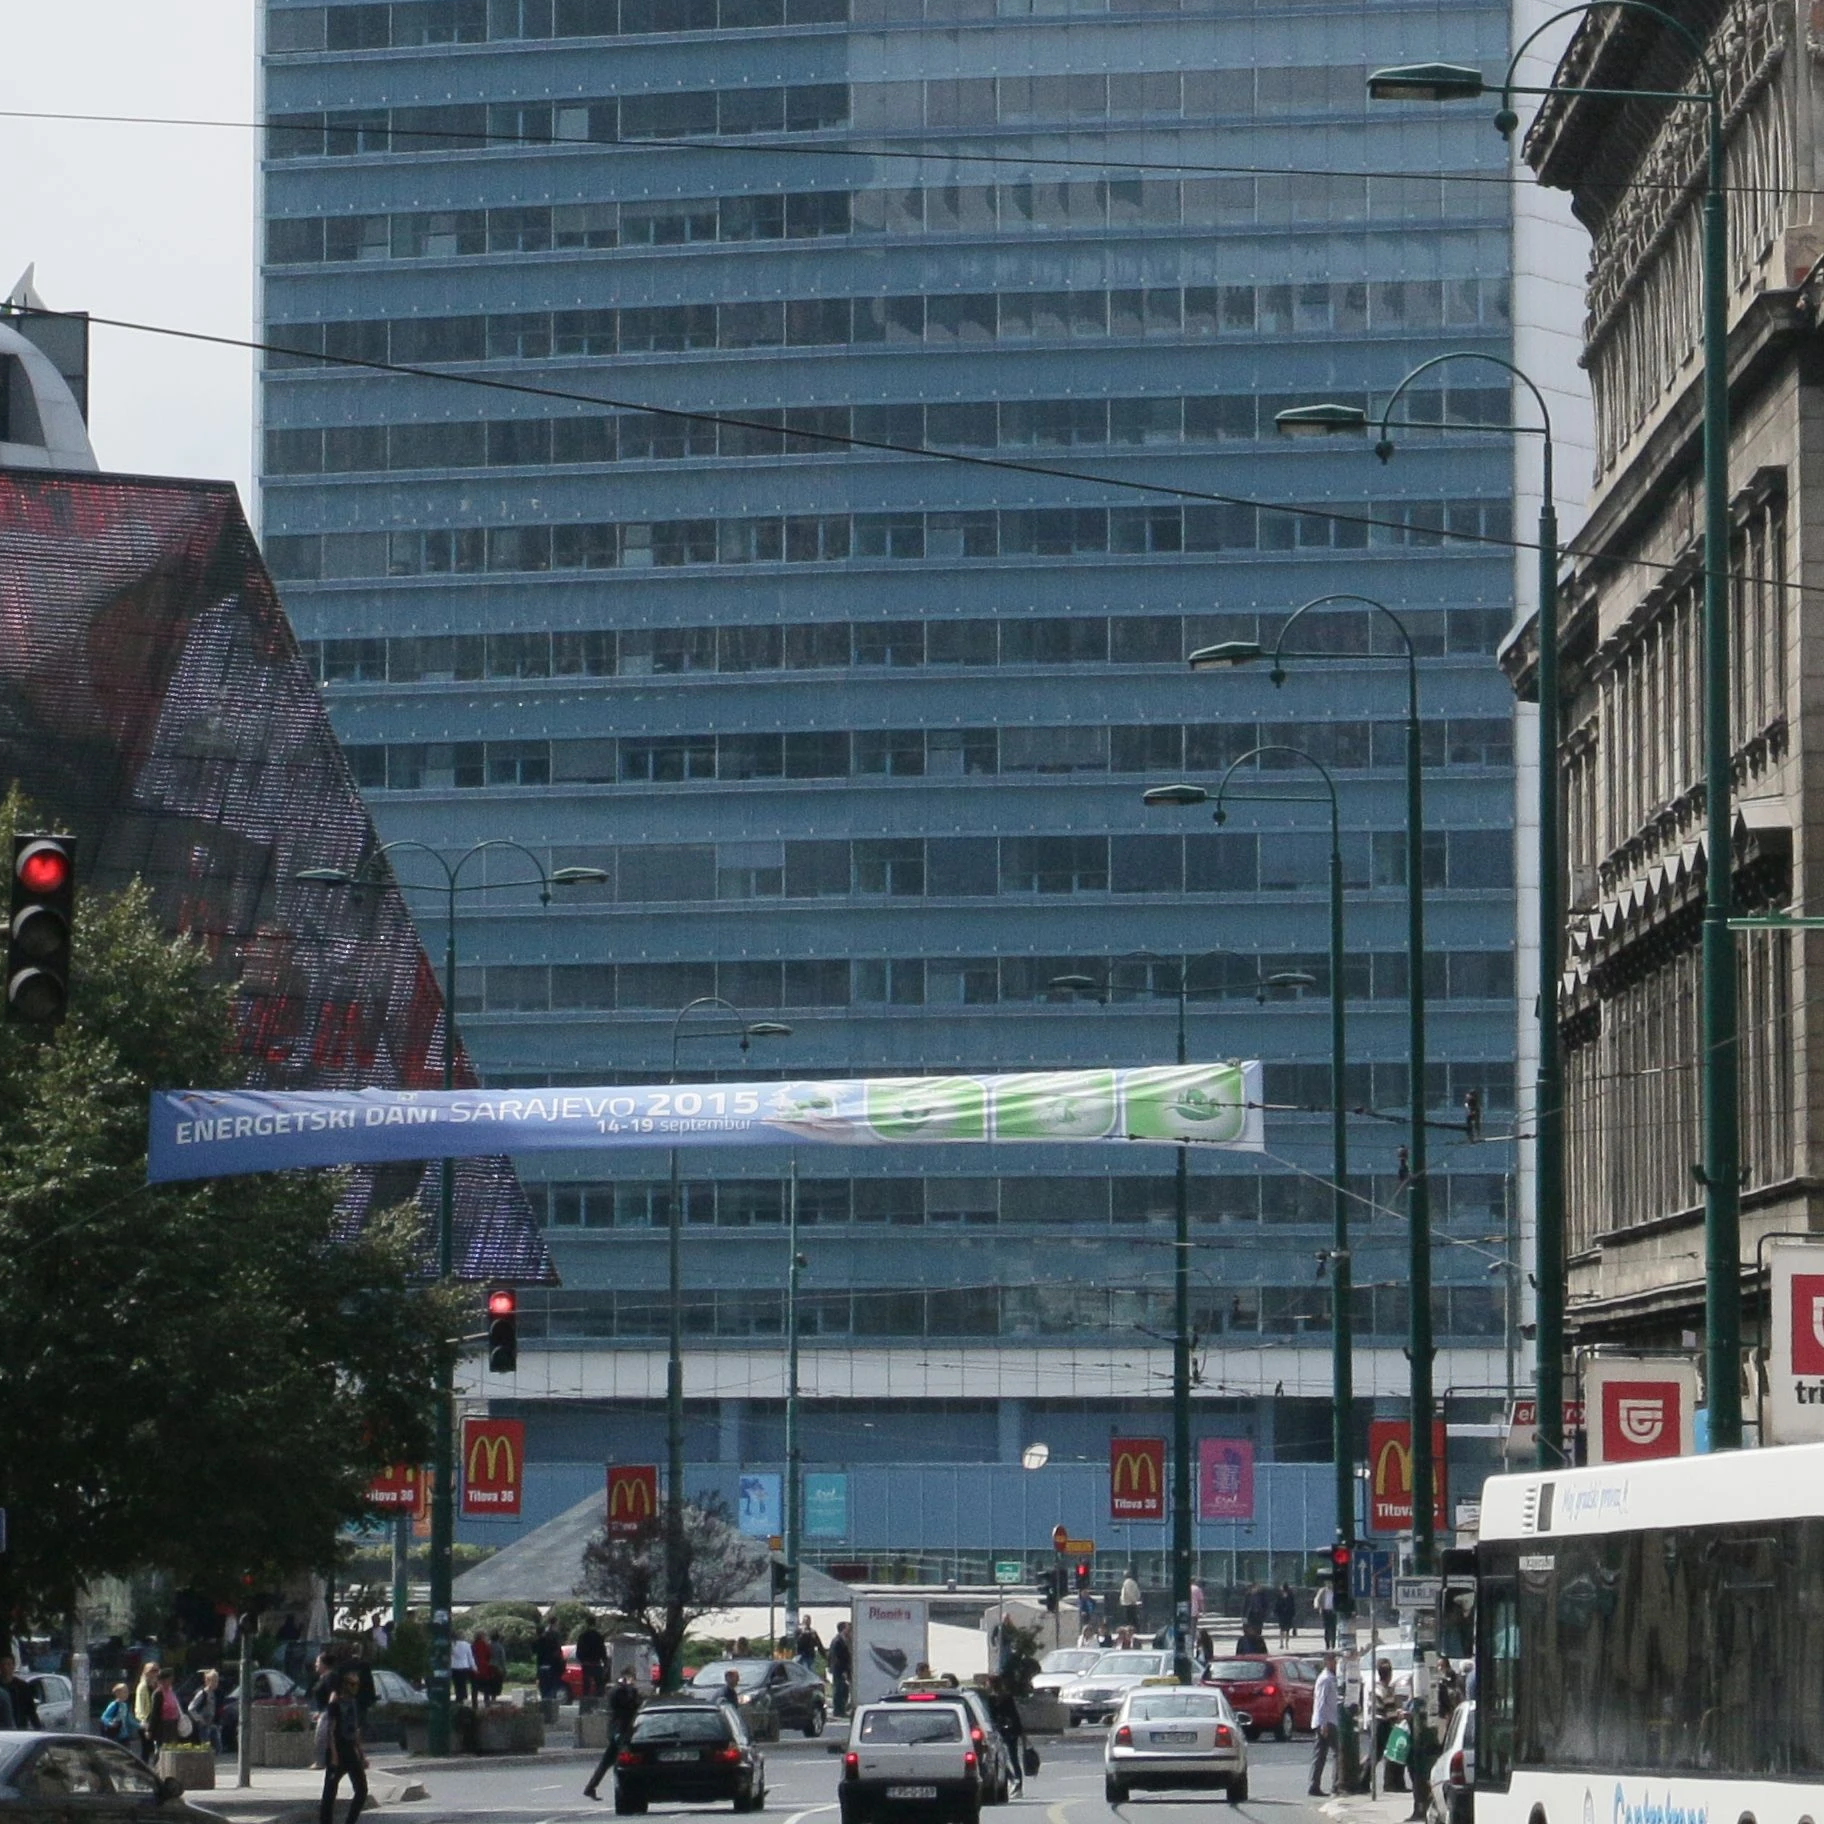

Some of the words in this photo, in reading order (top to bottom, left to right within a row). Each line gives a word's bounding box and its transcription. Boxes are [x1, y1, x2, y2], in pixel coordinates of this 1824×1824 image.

[176, 1110, 356, 1145] ENERGETSKI
[365, 1106, 438, 1128] DANI
[449, 1095, 636, 1124] SARAJEVO
[646, 1090, 760, 1117] 2015
[597, 1117, 654, 1134] 14-19
[468, 1489, 498, 1503] Titova
[501, 1489, 514, 1503] 36
[1114, 1498, 1143, 1510] Titova
